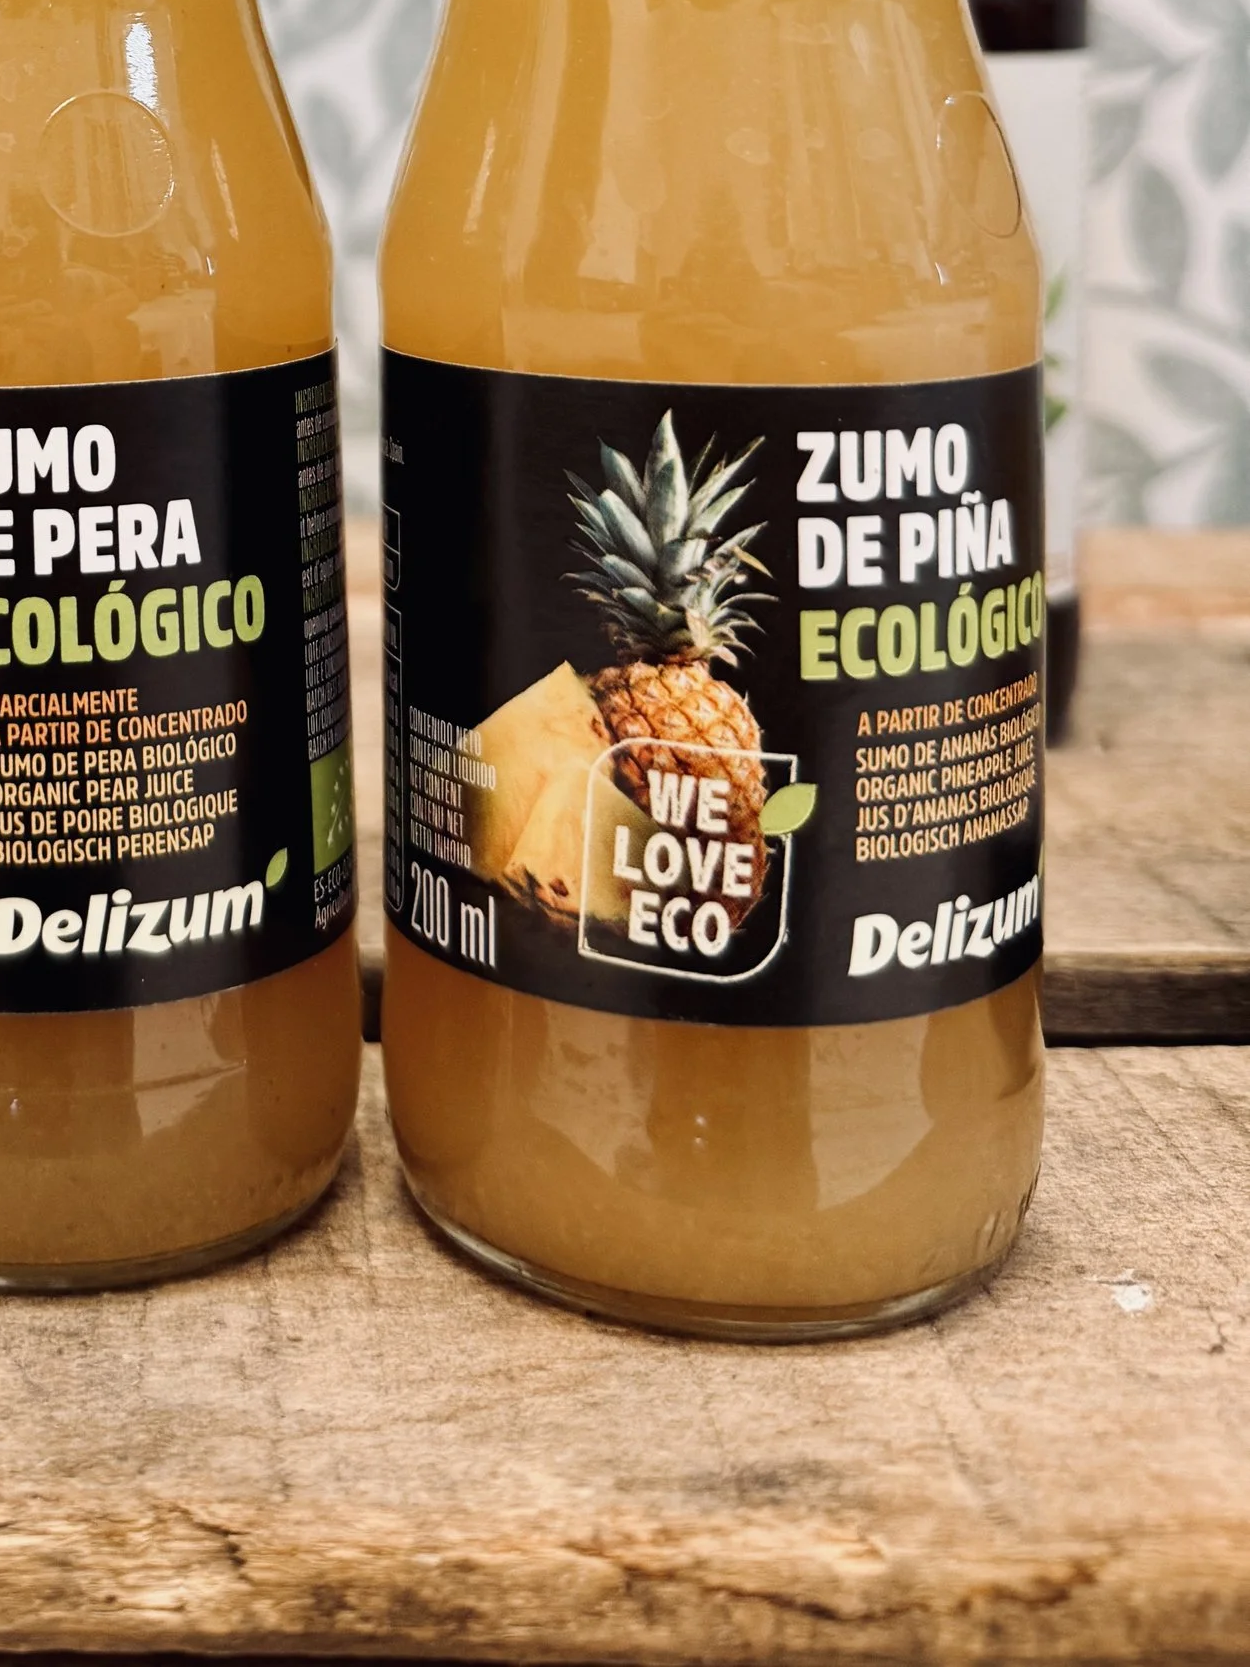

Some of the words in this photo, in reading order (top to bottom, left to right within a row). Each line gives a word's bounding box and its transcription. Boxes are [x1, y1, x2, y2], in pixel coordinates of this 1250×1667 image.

[796, 423, 967, 502] ZUMO
[33, 499, 201, 575] PERA
[797, 515, 883, 589] DE
[899, 490, 1012, 583] PIÑA
[800, 570, 1043, 680] ECOLÓGICO
[7, 721, 80, 747] PARTIR
[86, 719, 112, 744] DE
[117, 700, 247, 742] CONCENTRADO
[409, 705, 453, 747] CONTENIDO
[456, 726, 482, 756] NETO
[857, 711, 871, 736] A
[877, 704, 940, 734] PARTIR
[943, 699, 963, 726] DE
[967, 671, 1038, 721] CONCENTRADO
[52, 752, 78, 776] DE
[84, 748, 137, 774] PERA
[142, 733, 237, 769] BIOLÓGICO
[855, 744, 909, 773] SUMO
[913, 739, 937, 767] DE
[940, 724, 997, 762] ANANÁS
[855, 769, 937, 803] ORGANIC
[941, 749, 1012, 791] PINEAPPLE
[1013, 736, 1035, 768] JUICE
[31, 811, 57, 835] DE
[63, 806, 123, 833] POIRE
[129, 789, 238, 829] BIOLOGIQUE
[86, 776, 139, 803] PEAR
[144, 769, 194, 798] JUICE
[409, 762, 422, 787] NET
[424, 770, 462, 808] CONTENT
[410, 790, 444, 829] CONTENU
[446, 808, 464, 837] NET
[647, 769, 730, 833] WE
[856, 805, 889, 832] JUS
[894, 790, 977, 829] D'ANANAS
[980, 762, 1035, 808] BIOLOGIQUE
[117, 823, 214, 859] PERENSAP
[410, 818, 432, 853] NETTO
[434, 832, 471, 869] INHOUD
[856, 823, 960, 861] BIOLOGISCH
[963, 796, 1030, 843] ANANASSAP
[613, 825, 754, 898] LOVE
[411, 861, 449, 948] 200
[460, 895, 495, 967] ml
[628, 889, 730, 957] ECO
[847, 874, 1038, 976] Delizum
